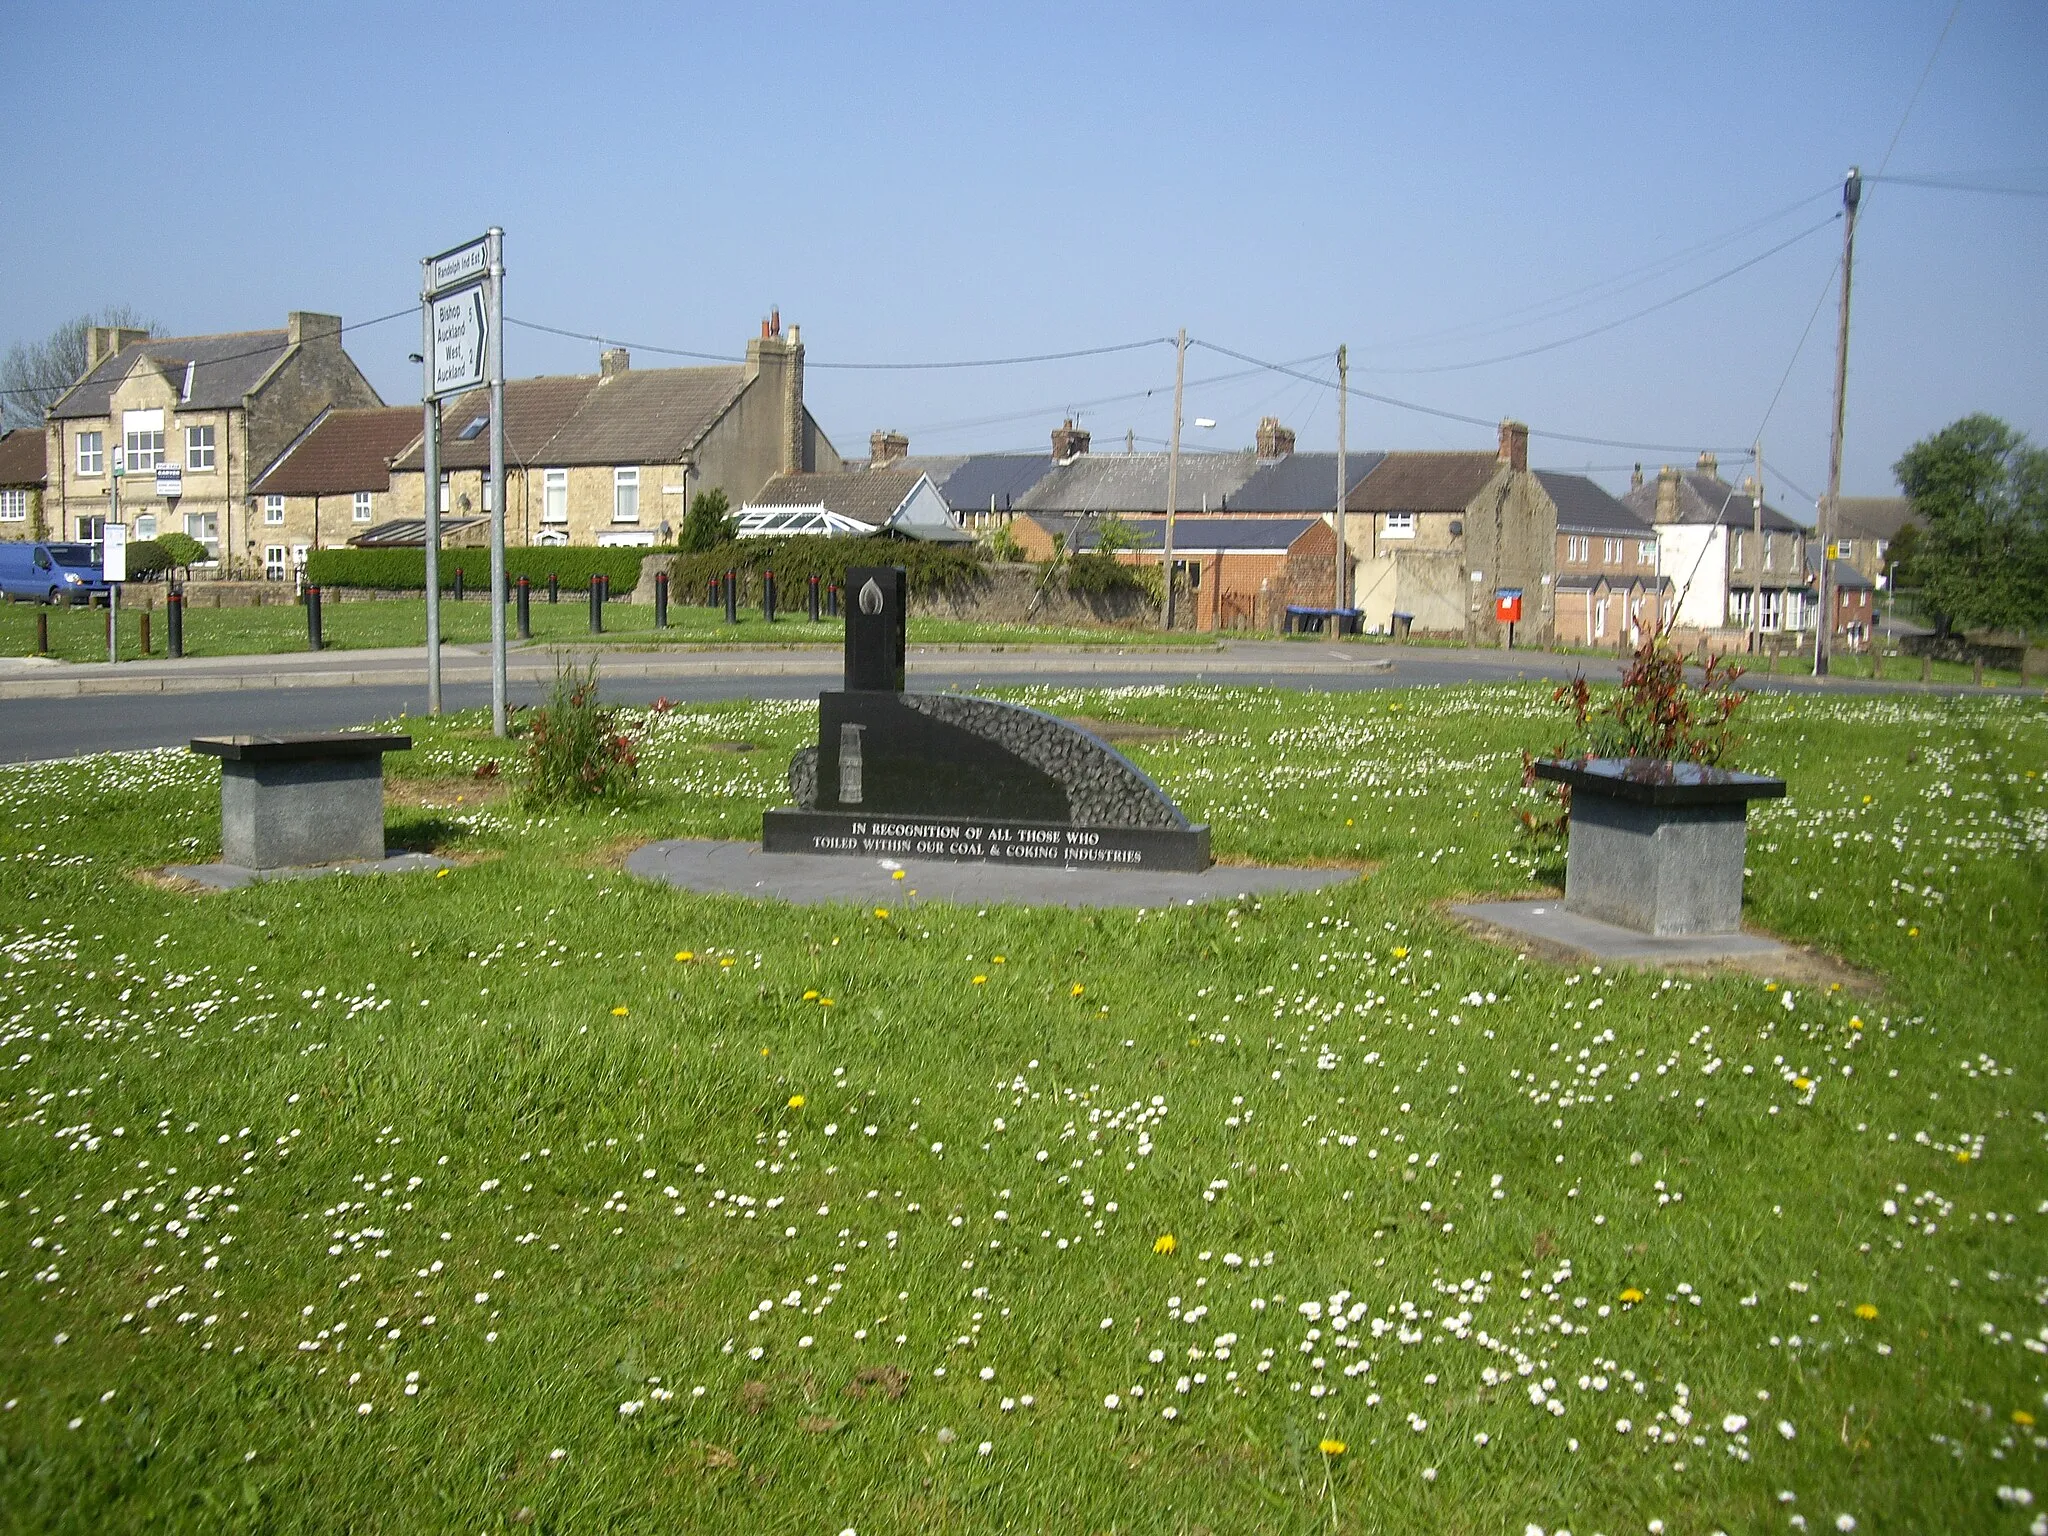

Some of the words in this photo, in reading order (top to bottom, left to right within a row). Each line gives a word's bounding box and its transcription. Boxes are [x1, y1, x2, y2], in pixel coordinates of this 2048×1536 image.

[438, 259, 460, 279] Randolph
[461, 255, 470, 270] Ind
[471, 252, 480, 266] Est
[440, 304, 460, 322] Bishop
[468, 306, 473, 322] 5
[437, 320, 465, 344] Auckland
[469, 348, 473, 364] 2
[437, 361, 465, 384] Auckland
[852, 822, 867, 835] IN
[872, 823, 960, 839] RECOGNITION
[965, 827, 983, 840] OF
[988, 828, 1012, 841] ALL
[1017, 830, 1061, 844] THOSE
[1066, 832, 1100, 846] WHO
[813, 836, 858, 849] TOILED
[863, 838, 911, 852] WITHIN
[916, 840, 944, 854] OUR
[950, 842, 985, 855] COAL
[990, 844, 1000, 857] &
[1006, 844, 1058, 859] COKING
[1064, 847, 1142, 863] INDUSTRIES
